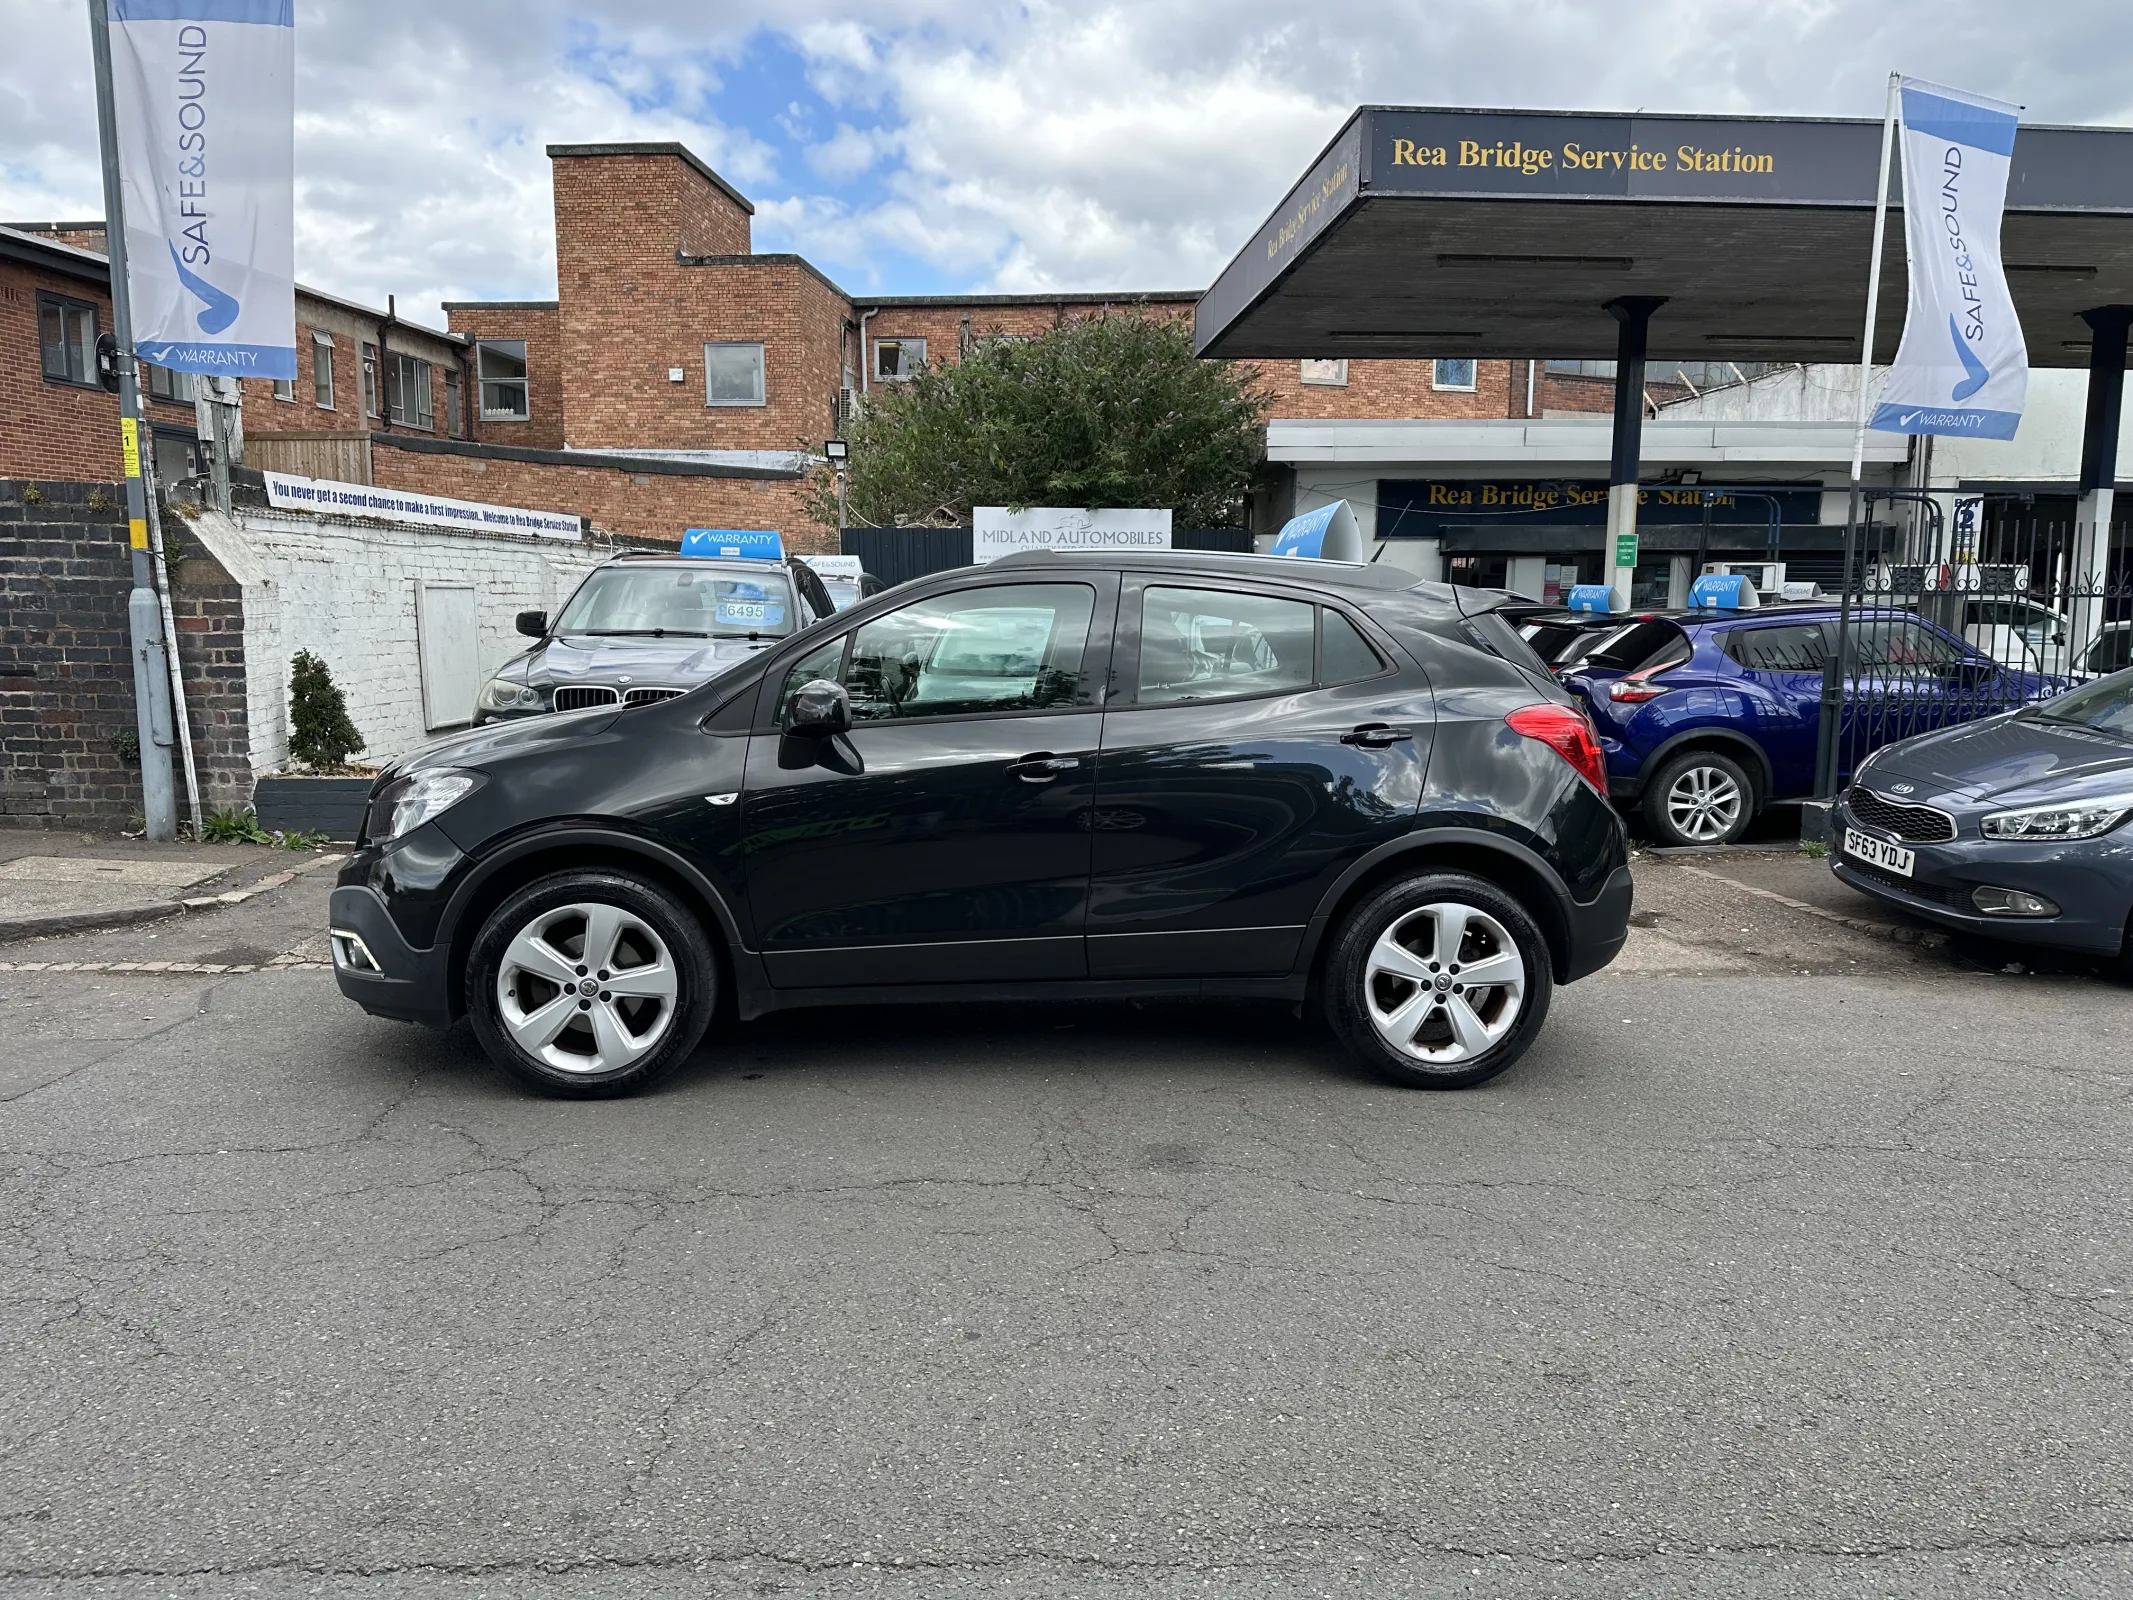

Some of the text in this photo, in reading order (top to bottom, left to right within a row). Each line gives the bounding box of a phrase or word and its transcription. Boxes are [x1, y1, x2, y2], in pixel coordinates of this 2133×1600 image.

[178, 25, 210, 265] SAFE&SOUND
[1391, 138, 1774, 175] Rea Bridge Service Station
[1267, 163, 1348, 261] Rea Bridge Service Station
[1942, 146, 1983, 341] SAFE&SOUND
[175, 348, 258, 368] WARRANTY
[1919, 412, 1987, 429] WARRANTY
[123, 435, 130, 447] 1
[272, 480, 290, 498] You
[291, 486, 316, 501] never
[316, 489, 331, 503] get
[332, 493, 338, 503] a
[339, 493, 367, 507] second
[368, 496, 396, 510] chance
[396, 499, 404, 511] to
[404, 501, 424, 514] make
[423, 504, 429, 514] a
[430, 503, 445, 517] first
[482, 510, 510, 525] Welcome
[509, 514, 516, 525] to
[515, 515, 527, 527] Rea
[526, 516, 544, 530] Bridge
[543, 517, 562, 530] Service
[562, 520, 578, 533] Station
[1428, 484, 1473, 506] Rea
[1480, 484, 1560, 511] Bridge
[707, 533, 774, 545] WARRANTY
[982, 529, 1163, 545] MIDLAND AUTOMOBILES
[809, 560, 856, 568] SAFE&SOUND
[1578, 589, 1608, 600] WARRANTY
[1703, 580, 1740, 592] WARRANTY
[717, 604, 764, 618] £6495
[1848, 831, 1908, 870] SF63 YDJ
